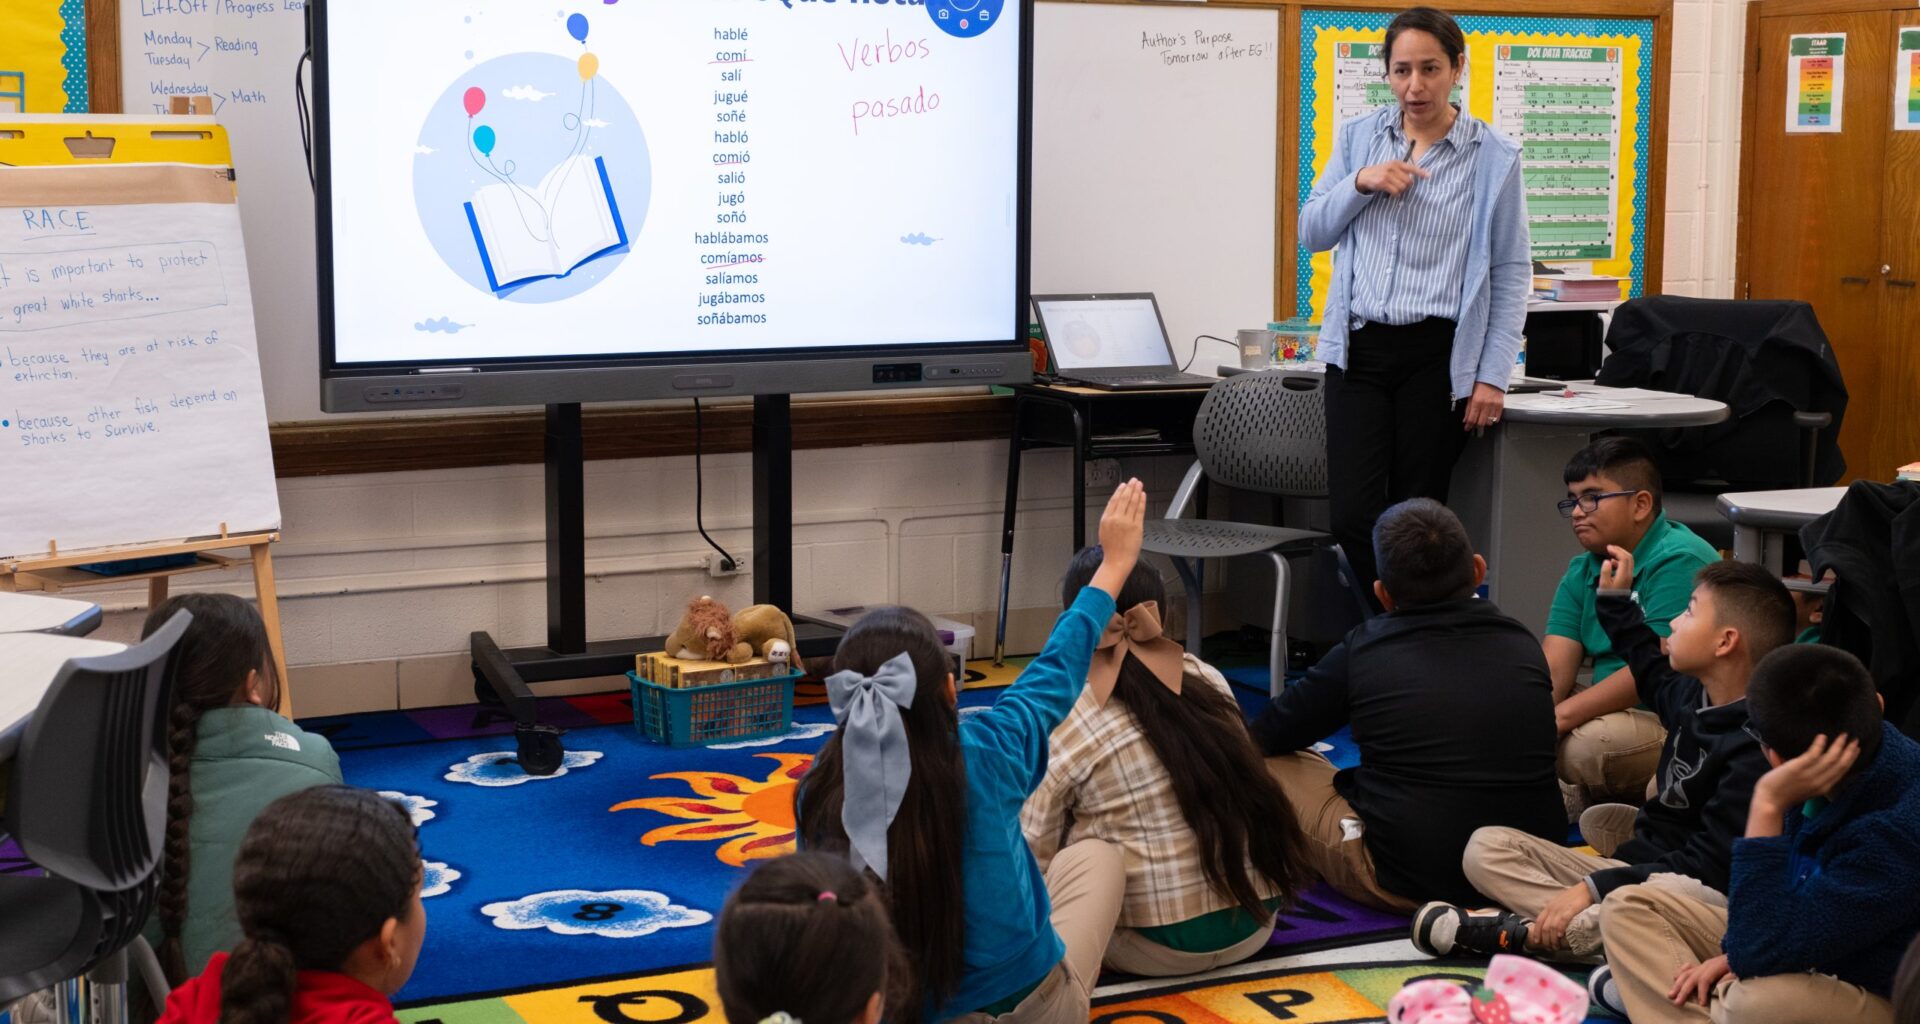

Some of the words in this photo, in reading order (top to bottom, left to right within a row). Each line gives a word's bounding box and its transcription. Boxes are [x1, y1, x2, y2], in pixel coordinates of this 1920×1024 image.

[144, 30, 192, 48] Monday
[714, 27, 748, 41] hablé
[1142, 31, 1186, 49] Author's
[1194, 29, 1233, 47] Purpose
[214, 36, 259, 56] Reading
[1527, 47, 1541, 58] DOL
[1542, 48, 1560, 58] DATA
[1562, 48, 1593, 59] TRACKER
[144, 52, 191, 69] Tuesday
[716, 48, 747, 61] comí
[1160, 50, 1209, 66] Tomorrow
[1218, 45, 1245, 61] after
[721, 69, 742, 82] salí
[1521, 68, 1539, 78] Math
[151, 80, 208, 95] Wednesday
[232, 88, 266, 103] Math
[713, 90, 749, 105] jugué
[716, 110, 746, 122] soñé
[853, 85, 939, 136] pasado
[714, 131, 749, 144] habló
[712, 150, 750, 163] comió
[718, 171, 746, 184] salió
[717, 191, 745, 206] jugó
[717, 211, 747, 223] soñó
[694, 232, 769, 244] hablábamos
[701, 251, 763, 264] comíamos
[0, 263, 11, 287] t
[25, 267, 40, 283] is
[51, 258, 116, 282] important
[128, 254, 144, 269] to
[159, 250, 208, 273] protect
[706, 272, 758, 284] salíamos
[698, 292, 766, 307] jugábamos
[13, 296, 48, 324] great
[60, 292, 94, 310] white
[697, 312, 767, 325] soñábamos
[7, 346, 70, 368] because
[82, 347, 109, 366] they
[118, 345, 136, 356] are
[146, 339, 158, 353] at
[168, 334, 198, 348] risk
[204, 330, 219, 345] of
[16, 408, 73, 430] because
[88, 408, 121, 424] other
[135, 396, 159, 414] fish
[170, 389, 217, 408] depend
[224, 390, 238, 401] on
[77, 427, 91, 440] to
[572, 902, 625, 921] 8
[1243, 988, 1315, 1020] P
